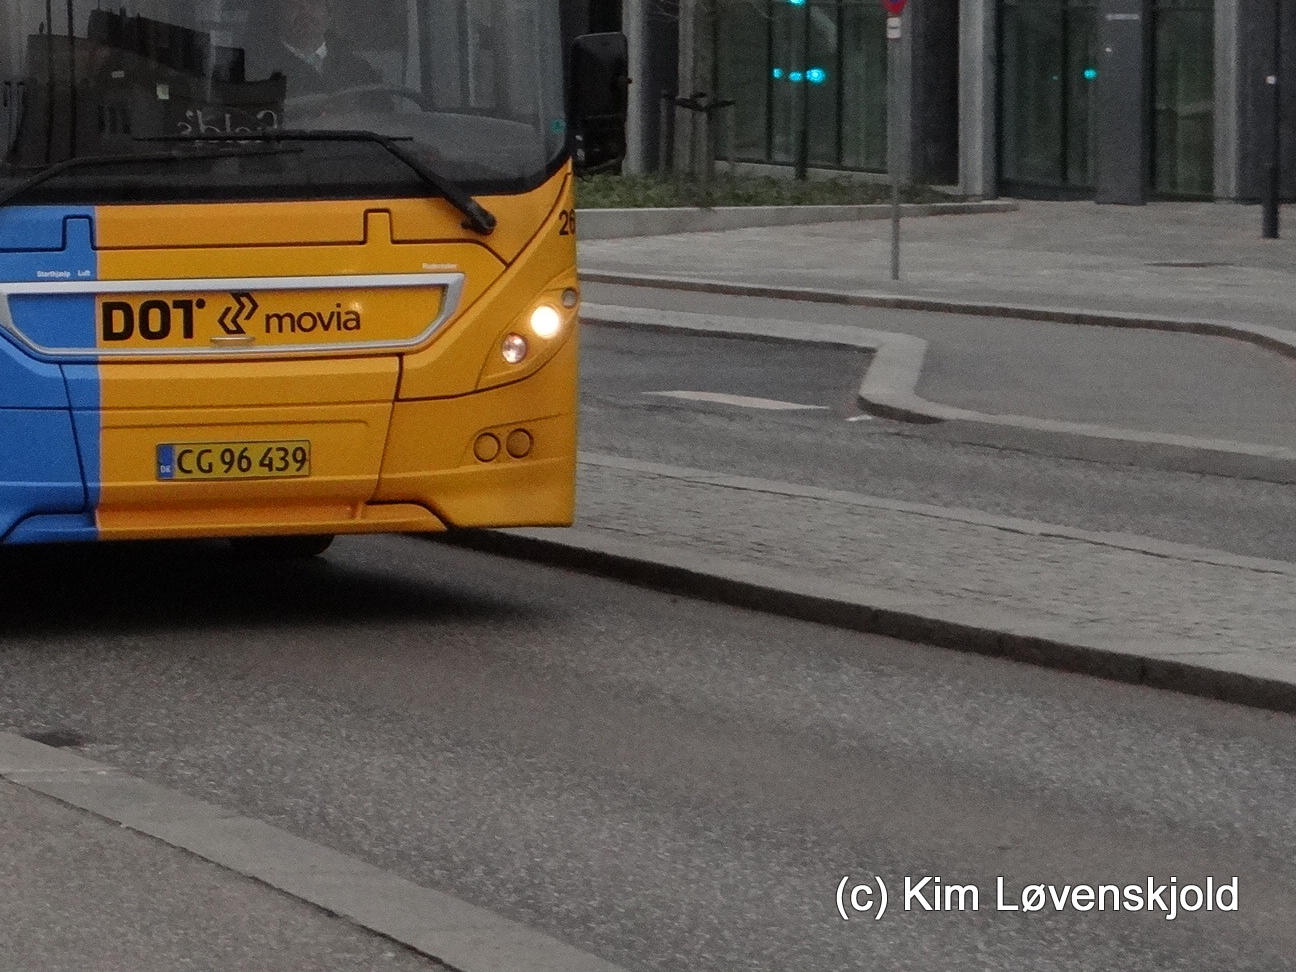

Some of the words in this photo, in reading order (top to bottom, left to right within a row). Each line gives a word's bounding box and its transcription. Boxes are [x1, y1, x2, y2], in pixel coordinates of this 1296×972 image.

[102, 298, 206, 341] DOT
[265, 303, 361, 334] movia
[177, 448, 213, 474] CG
[220, 447, 252, 474] 96
[259, 446, 307, 472] 439
